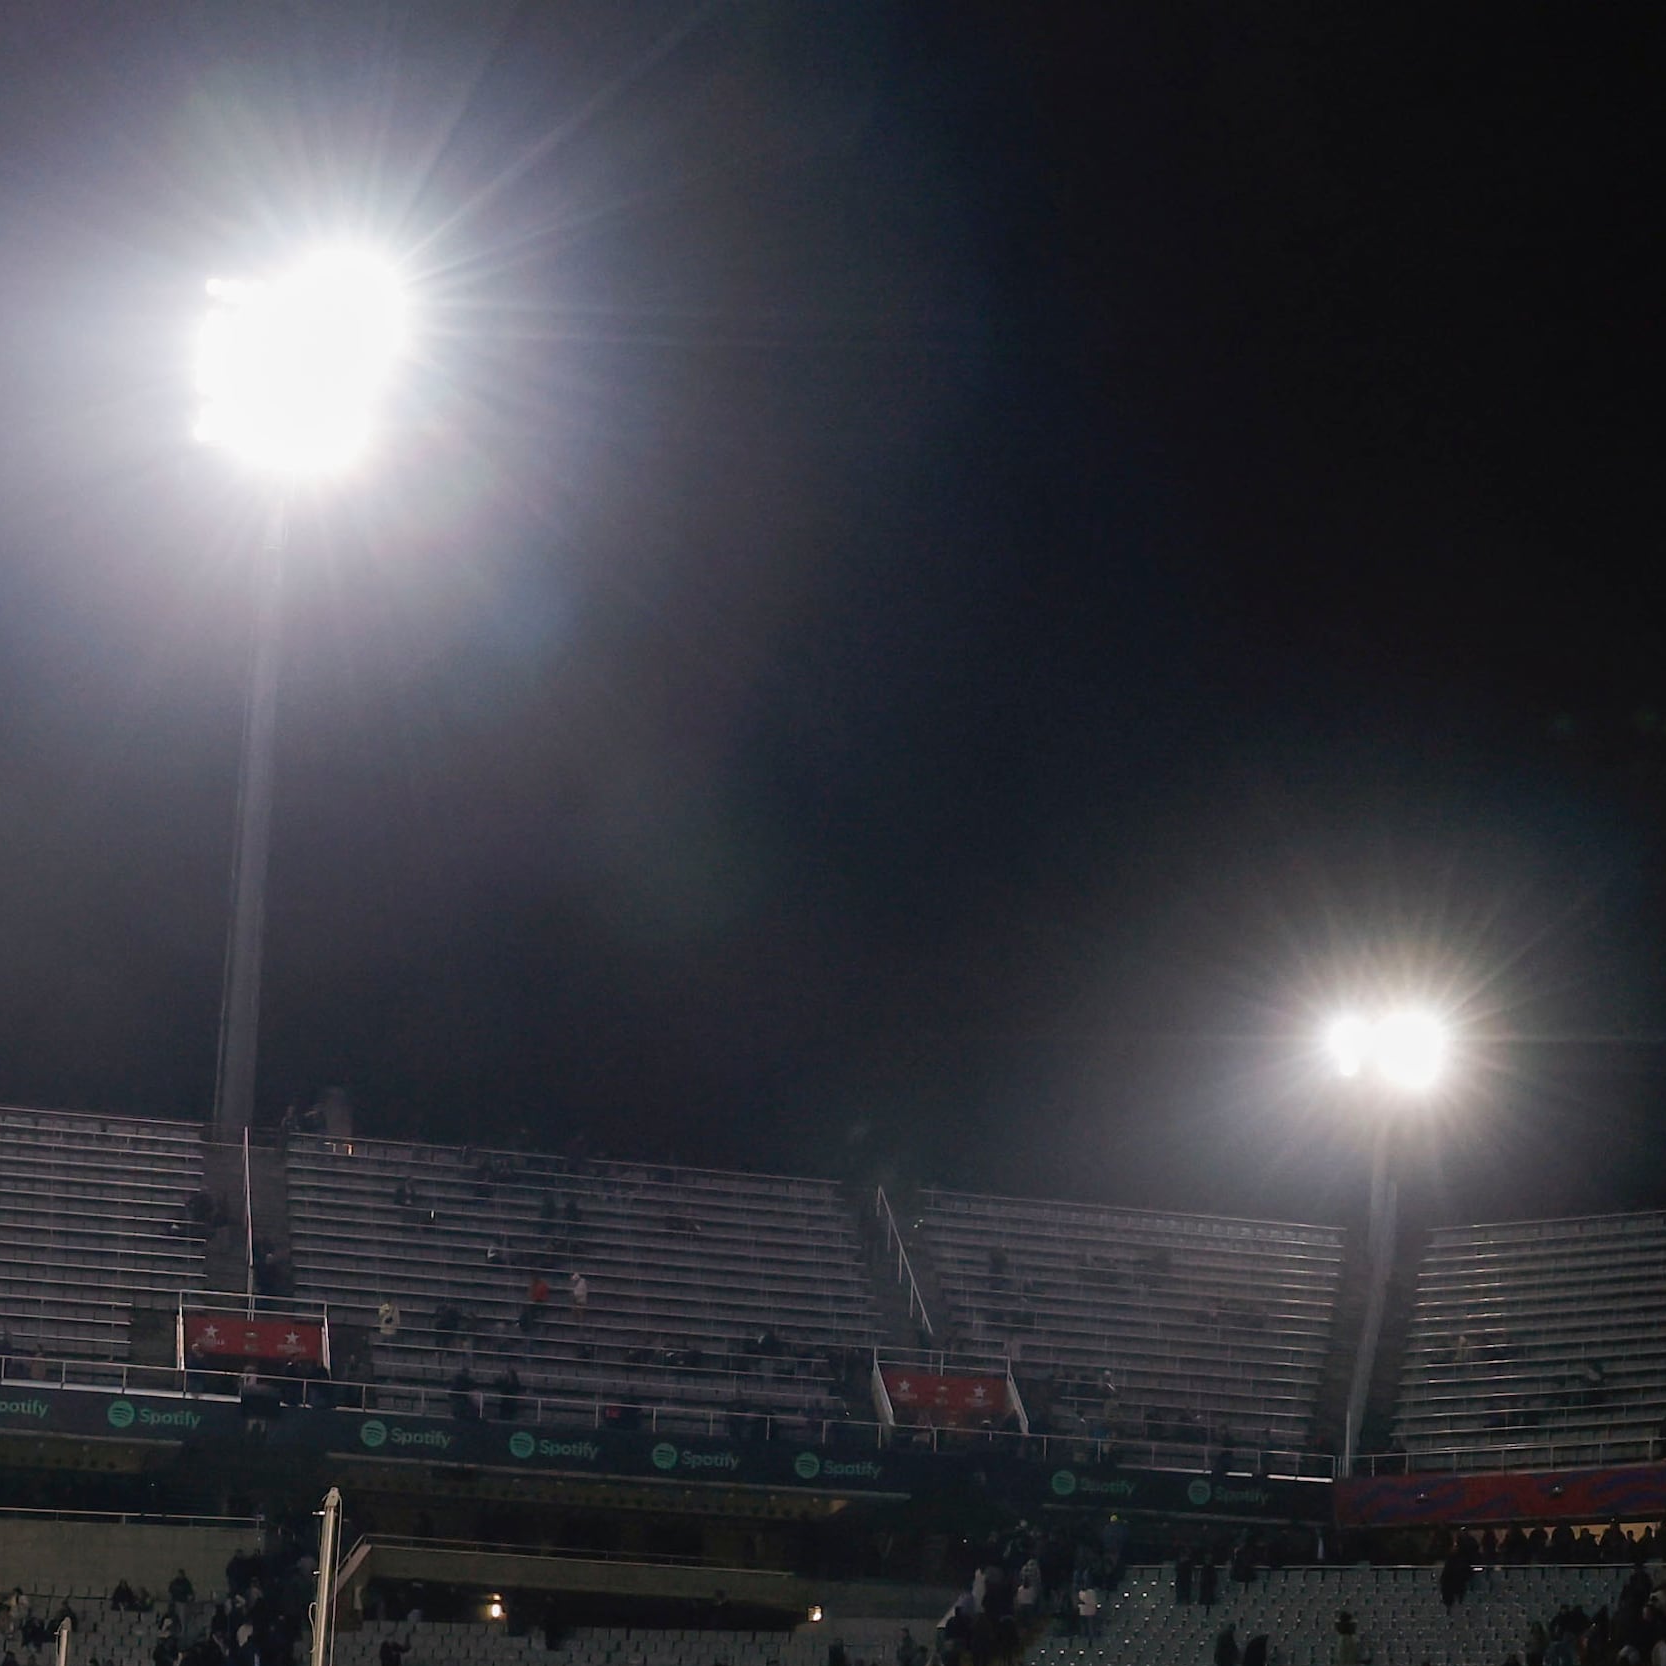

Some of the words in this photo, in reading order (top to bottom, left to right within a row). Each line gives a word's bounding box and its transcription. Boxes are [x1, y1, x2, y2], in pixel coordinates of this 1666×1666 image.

[138, 1407, 201, 1429] Spotify
[390, 1426, 451, 1450] Spotify
[538, 1438, 598, 1460] Spotify
[681, 1449, 741, 1471] Spotify
